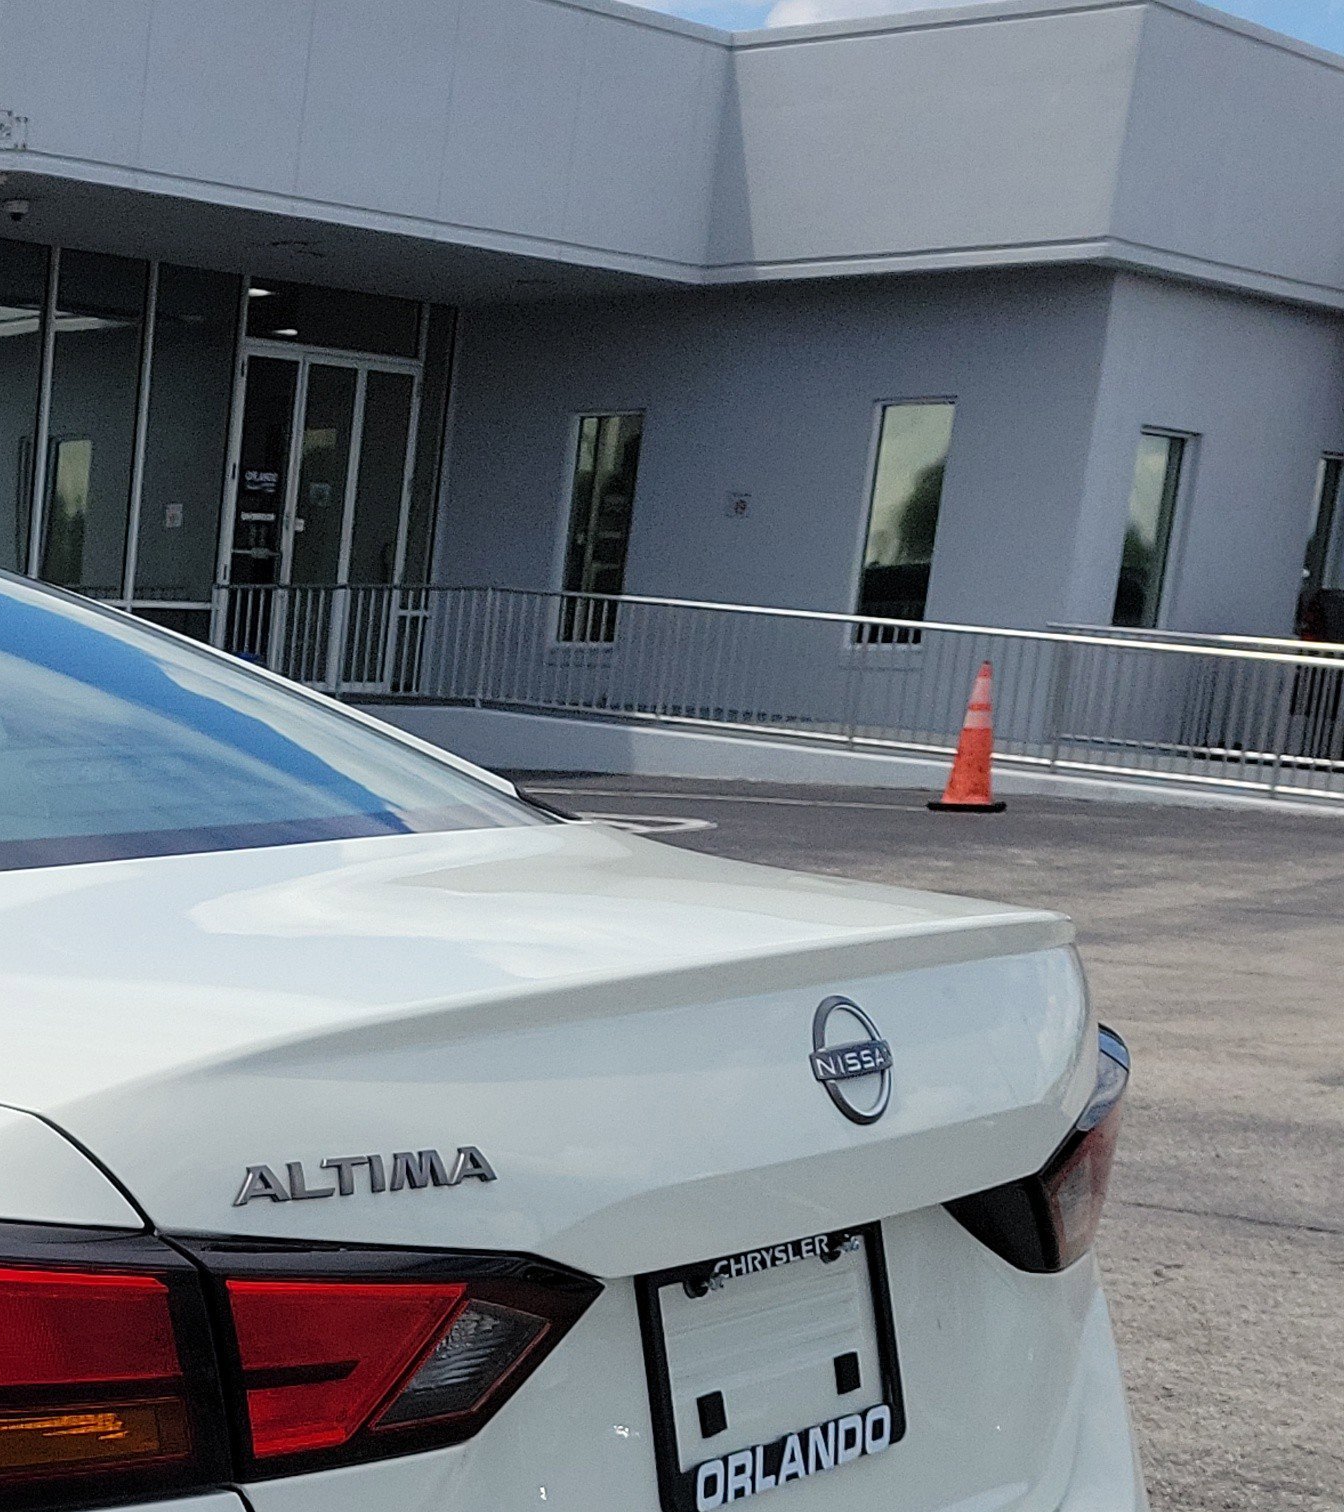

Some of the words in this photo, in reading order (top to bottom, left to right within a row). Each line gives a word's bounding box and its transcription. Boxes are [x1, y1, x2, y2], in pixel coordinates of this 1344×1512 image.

[815, 1048, 889, 1076] NISSA
[231, 1146, 498, 1207] ALTIMA
[714, 1234, 829, 1278] CHRYSLER
[696, 1404, 892, 1512] ORLANDO
